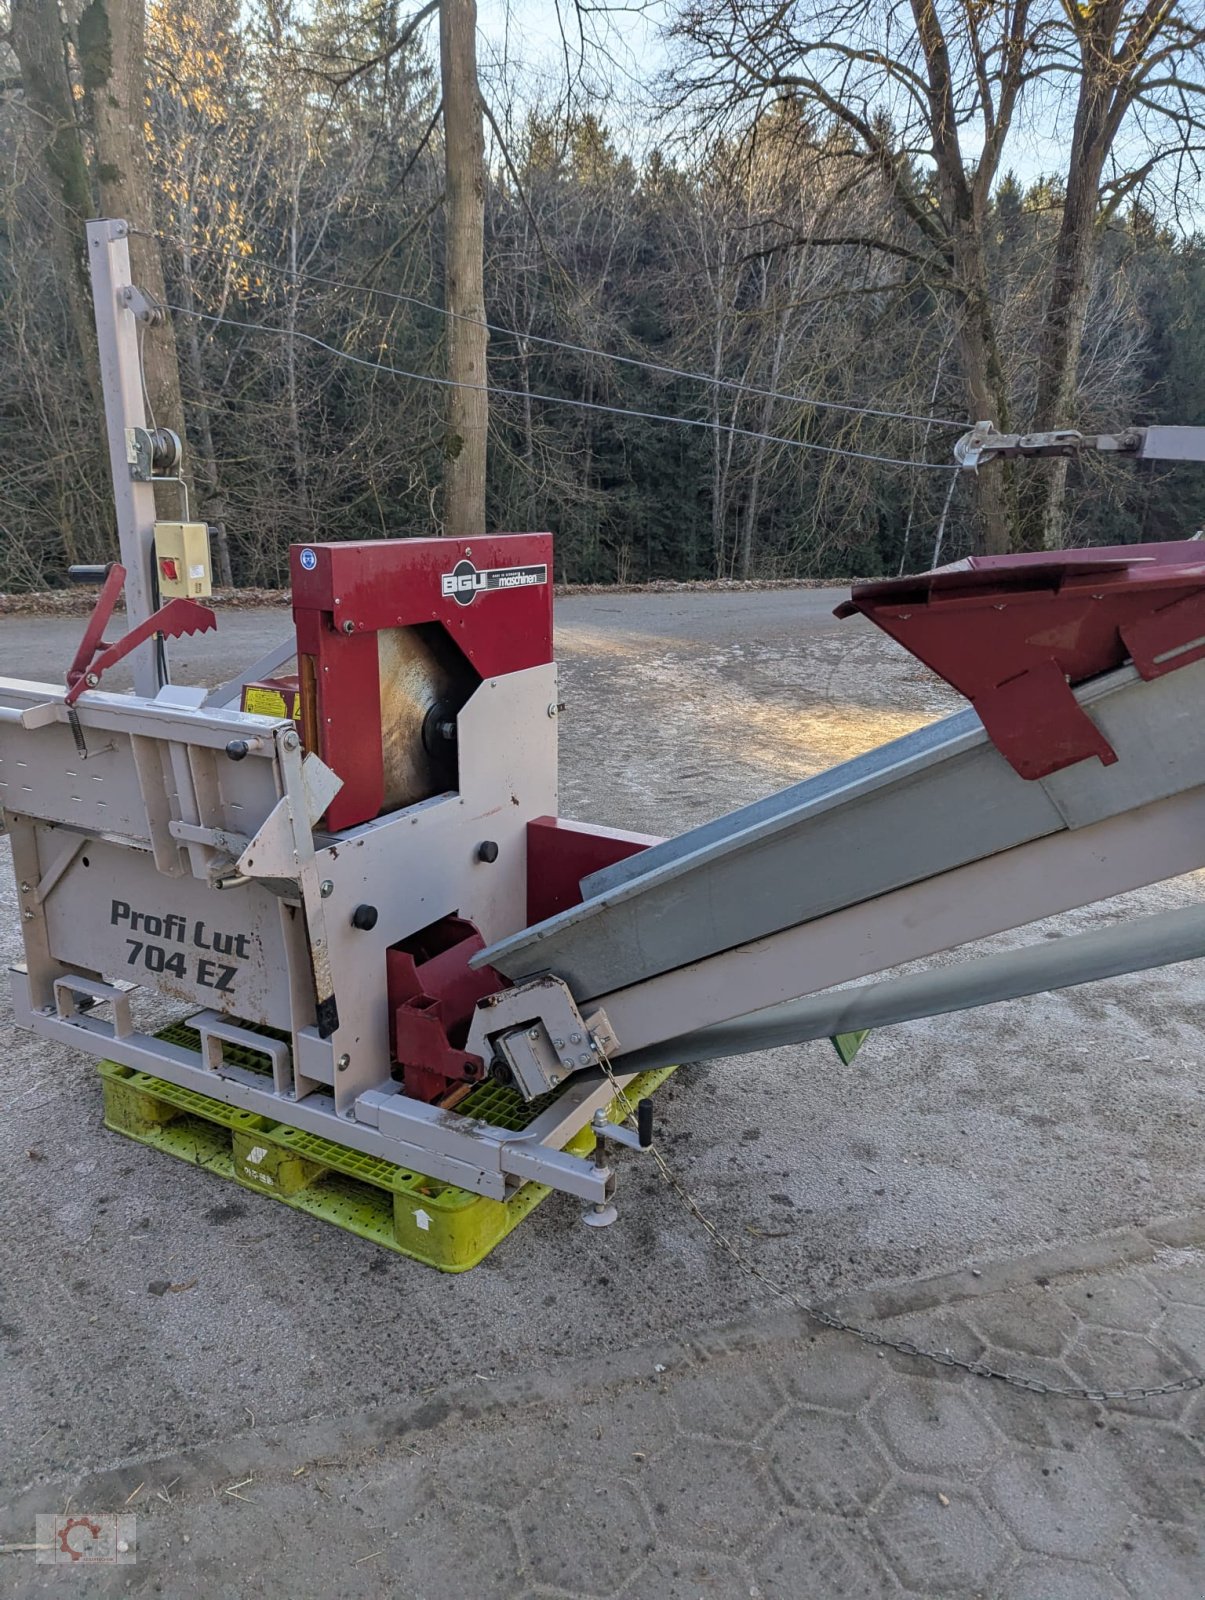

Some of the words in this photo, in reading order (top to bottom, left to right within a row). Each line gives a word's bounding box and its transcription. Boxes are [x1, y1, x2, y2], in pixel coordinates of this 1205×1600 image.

[443, 573, 486, 593] BGU
[499, 572, 537, 586] maschinen
[110, 899, 187, 943] Profi
[125, 938, 187, 980] 704
[196, 957, 238, 994] EZ
